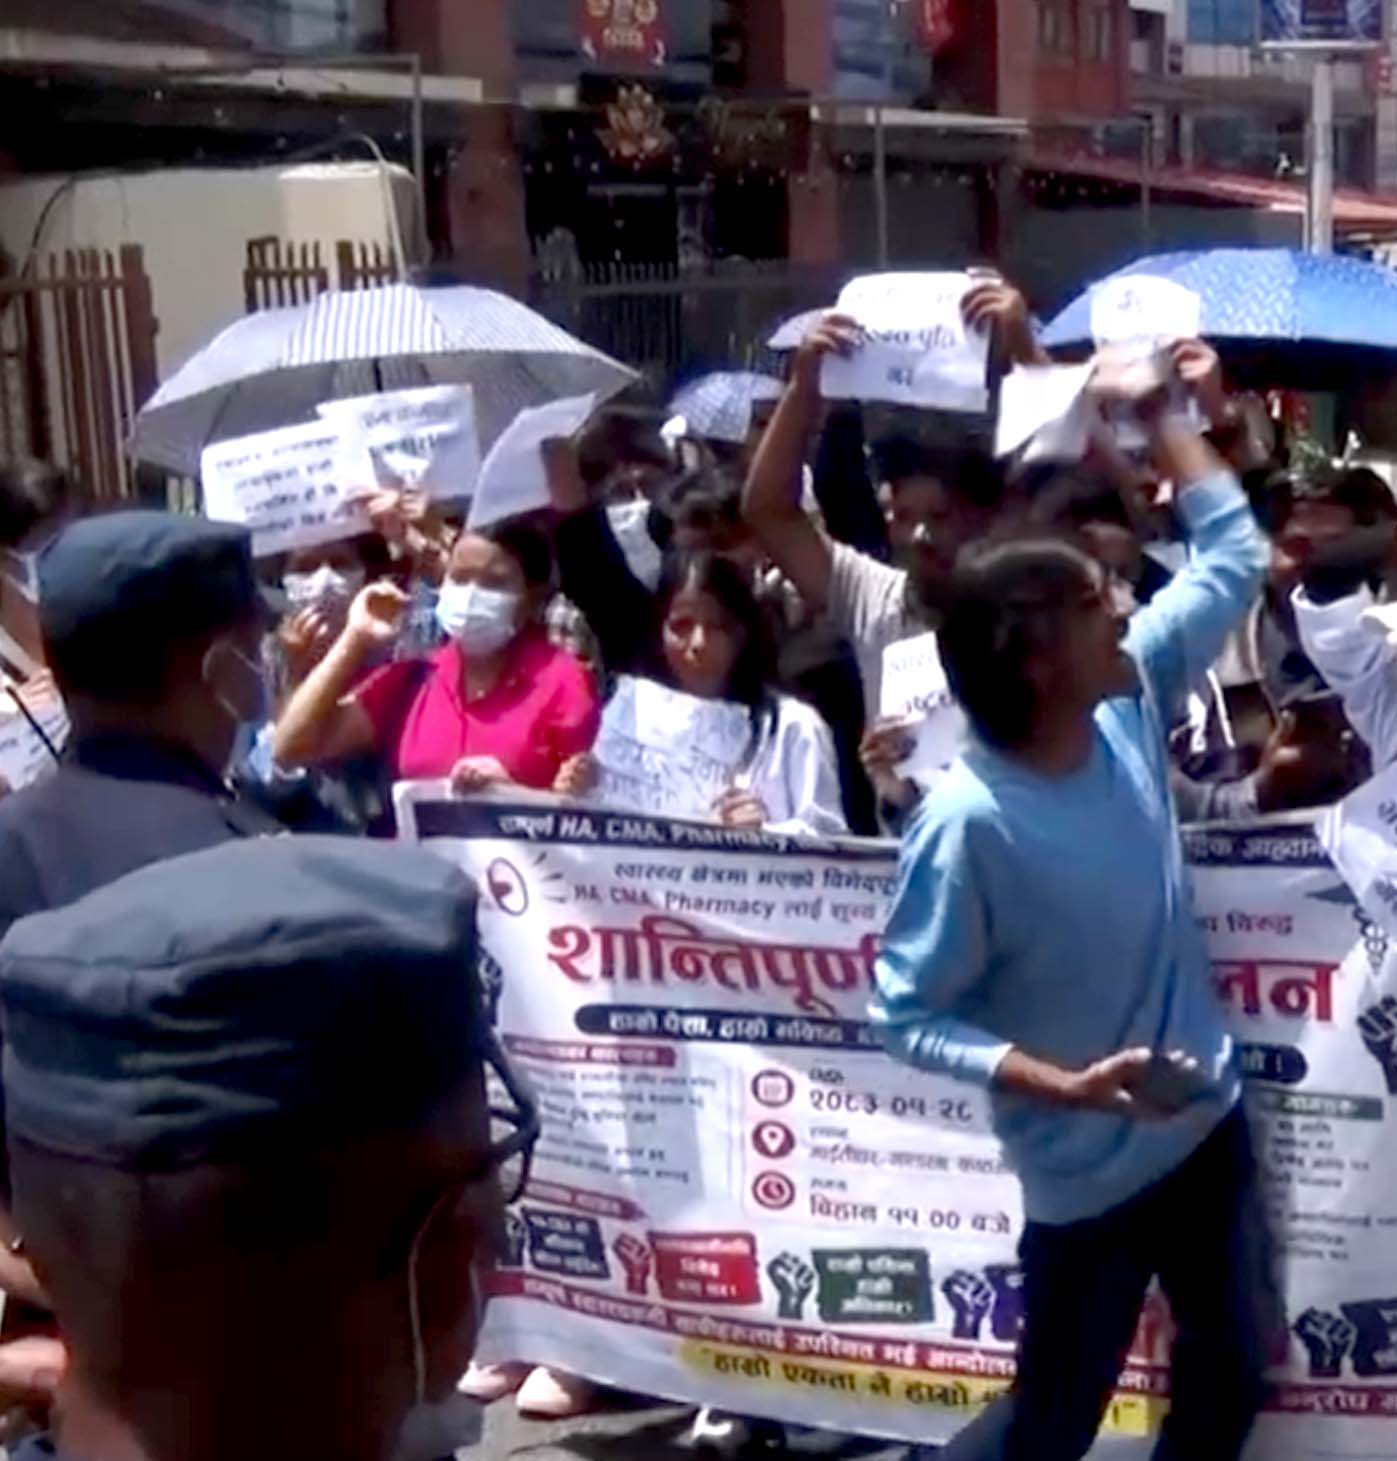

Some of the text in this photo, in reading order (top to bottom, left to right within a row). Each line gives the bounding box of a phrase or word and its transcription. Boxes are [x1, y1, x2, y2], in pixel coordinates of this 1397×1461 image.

[664, 890, 776, 919] Pharmacy
[546, 914, 886, 1024] शान्तिपूर्ण
[808, 1090, 880, 1116] २०८३
[809, 1193, 878, 1223] बिहान
[970, 1212, 1012, 1236] बजे
[782, 1362, 856, 1392] एकता
